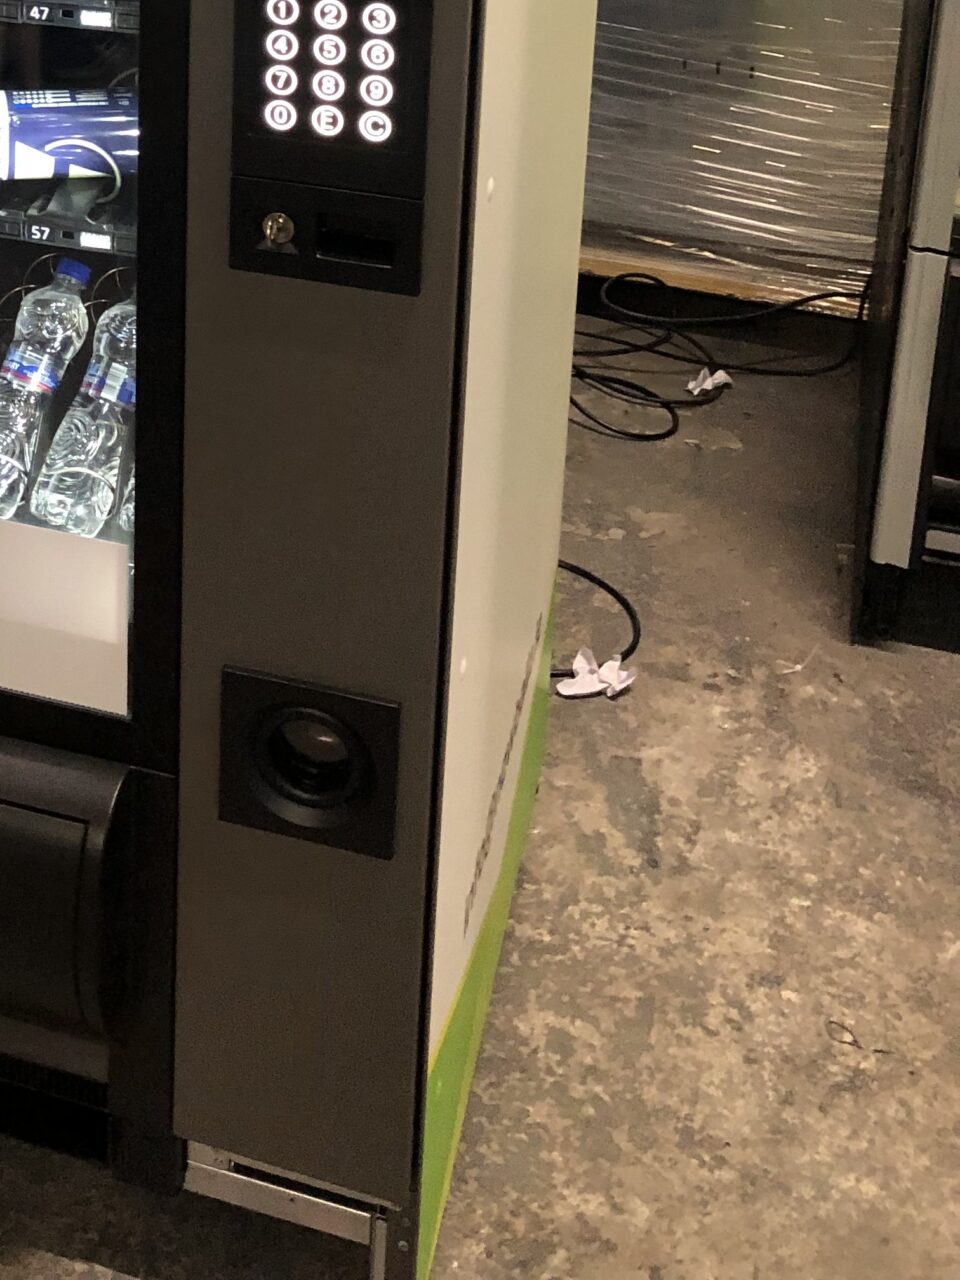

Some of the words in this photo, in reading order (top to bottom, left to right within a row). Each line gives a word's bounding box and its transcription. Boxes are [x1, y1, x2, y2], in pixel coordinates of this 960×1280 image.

[29, 5, 50, 21] 47
[277, 0, 287, 19] 1
[322, 4, 338, 24] 2
[371, 8, 387, 28] 3
[273, 35, 289, 54] 4
[322, 40, 337, 59] 5
[370, 44, 385, 65] 6
[275, 70, 288, 89] 7
[321, 75, 336, 94] 8
[369, 80, 384, 101] 9
[320, 110, 335, 130] E
[367, 115, 385, 135] C
[30, 226, 51, 240] 57
